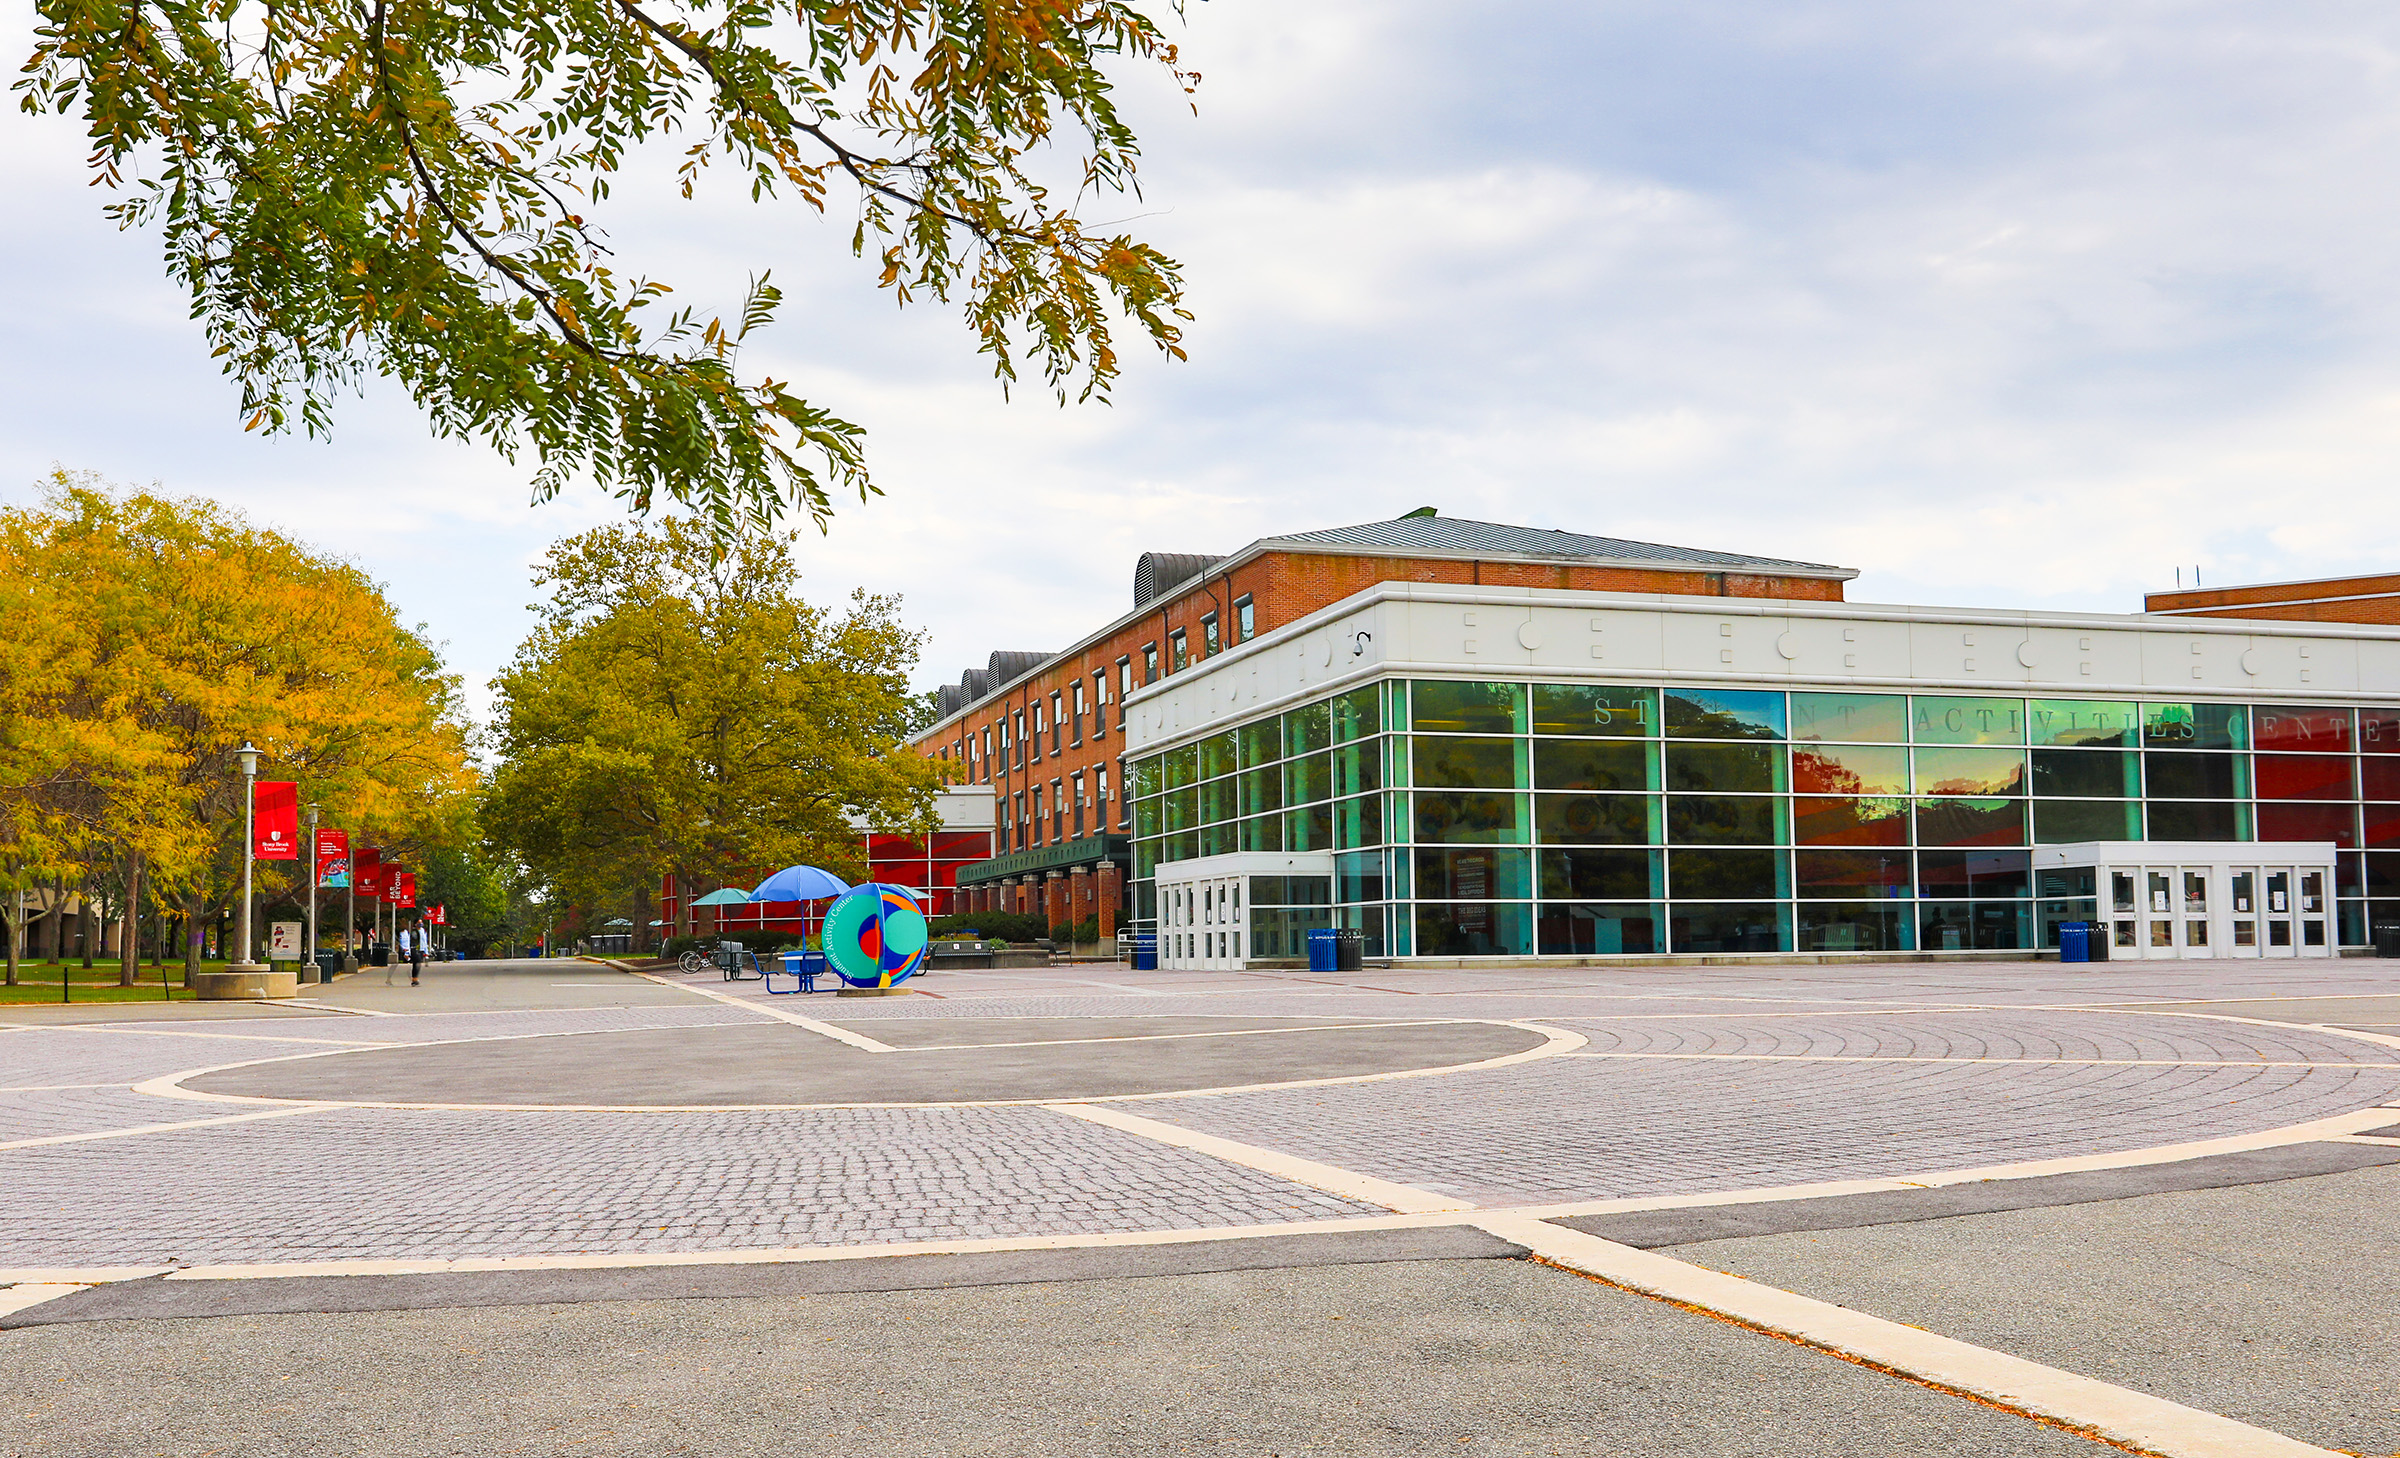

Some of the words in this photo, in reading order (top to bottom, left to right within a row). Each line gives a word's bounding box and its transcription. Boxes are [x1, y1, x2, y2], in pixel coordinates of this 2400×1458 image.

[1914, 706, 2196, 739] ACTIVITIES
[2227, 715, 2400, 742] CENTE
[830, 894, 853, 917] Center
[824, 918, 836, 951] Activity
[830, 952, 854, 980] Student
